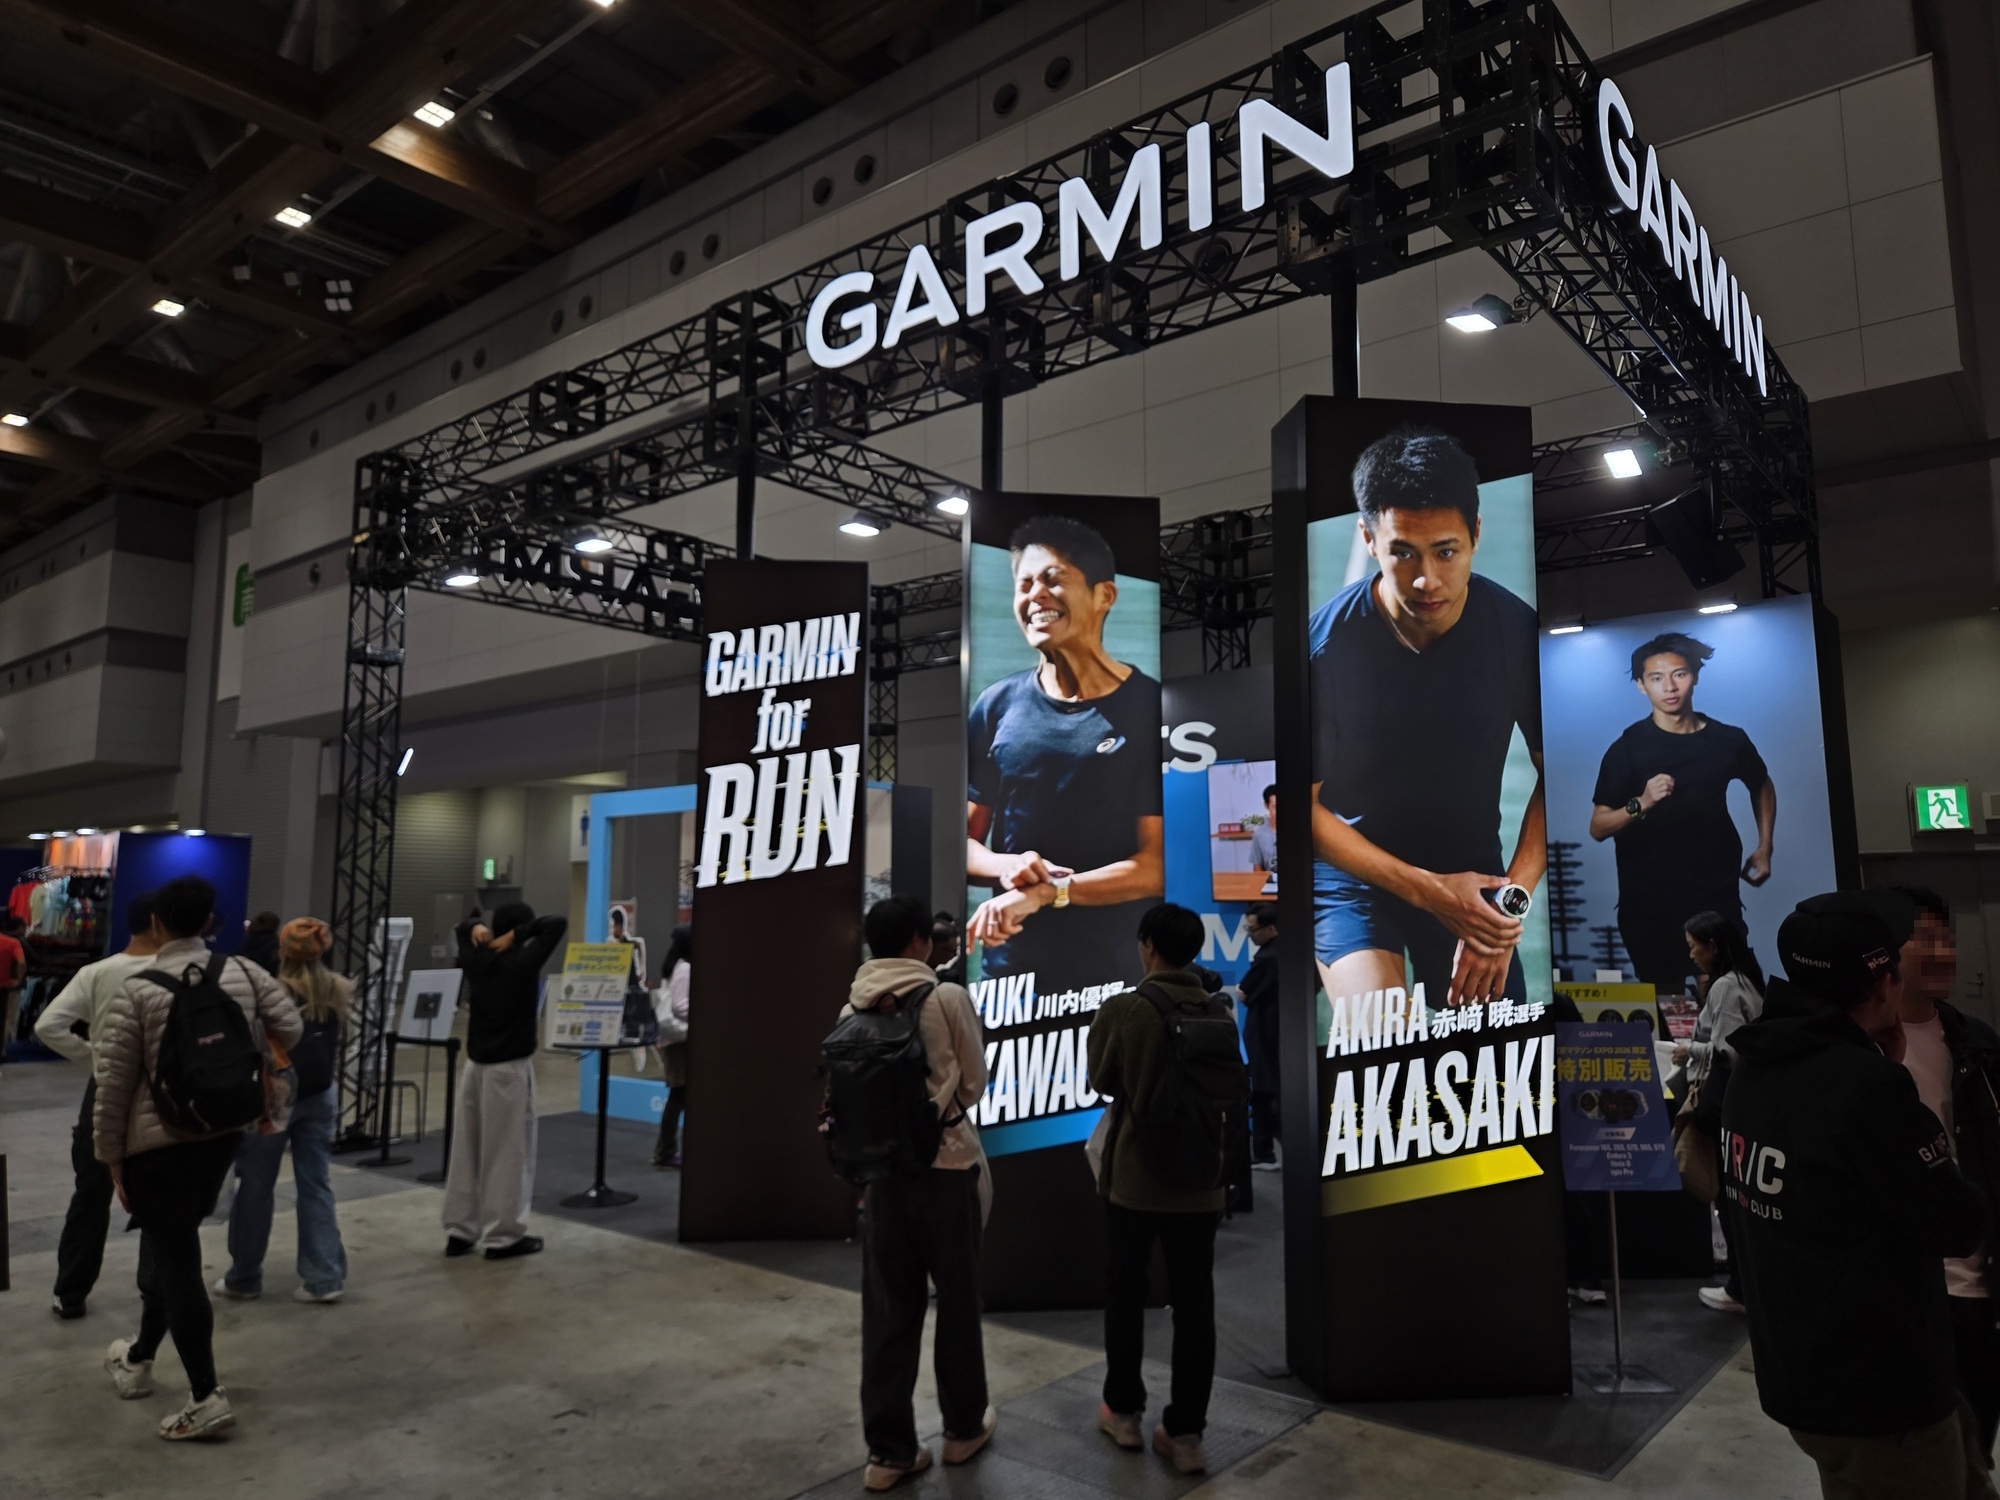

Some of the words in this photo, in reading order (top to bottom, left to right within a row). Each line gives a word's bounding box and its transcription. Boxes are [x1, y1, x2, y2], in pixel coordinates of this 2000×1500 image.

[804, 61, 1355, 369] GARMIN
[1597, 77, 1767, 398] GARMIN
[705, 611, 861, 697] GARMIN
[750, 687, 811, 755] for
[692, 744, 861, 889] RUN
[1792, 952, 1831, 969] GARMIN
[968, 972, 1036, 1030] YUKI
[1326, 982, 1429, 1059] AKIRA
[1578, 1031, 1613, 1039] GARMIN
[1557, 1057, 1652, 1083] 特別販売
[1594, 1046, 1613, 1055] EXPO
[1321, 1034, 1557, 1177] AKASAKI
[1750, 1199, 1784, 1221] CLUB
